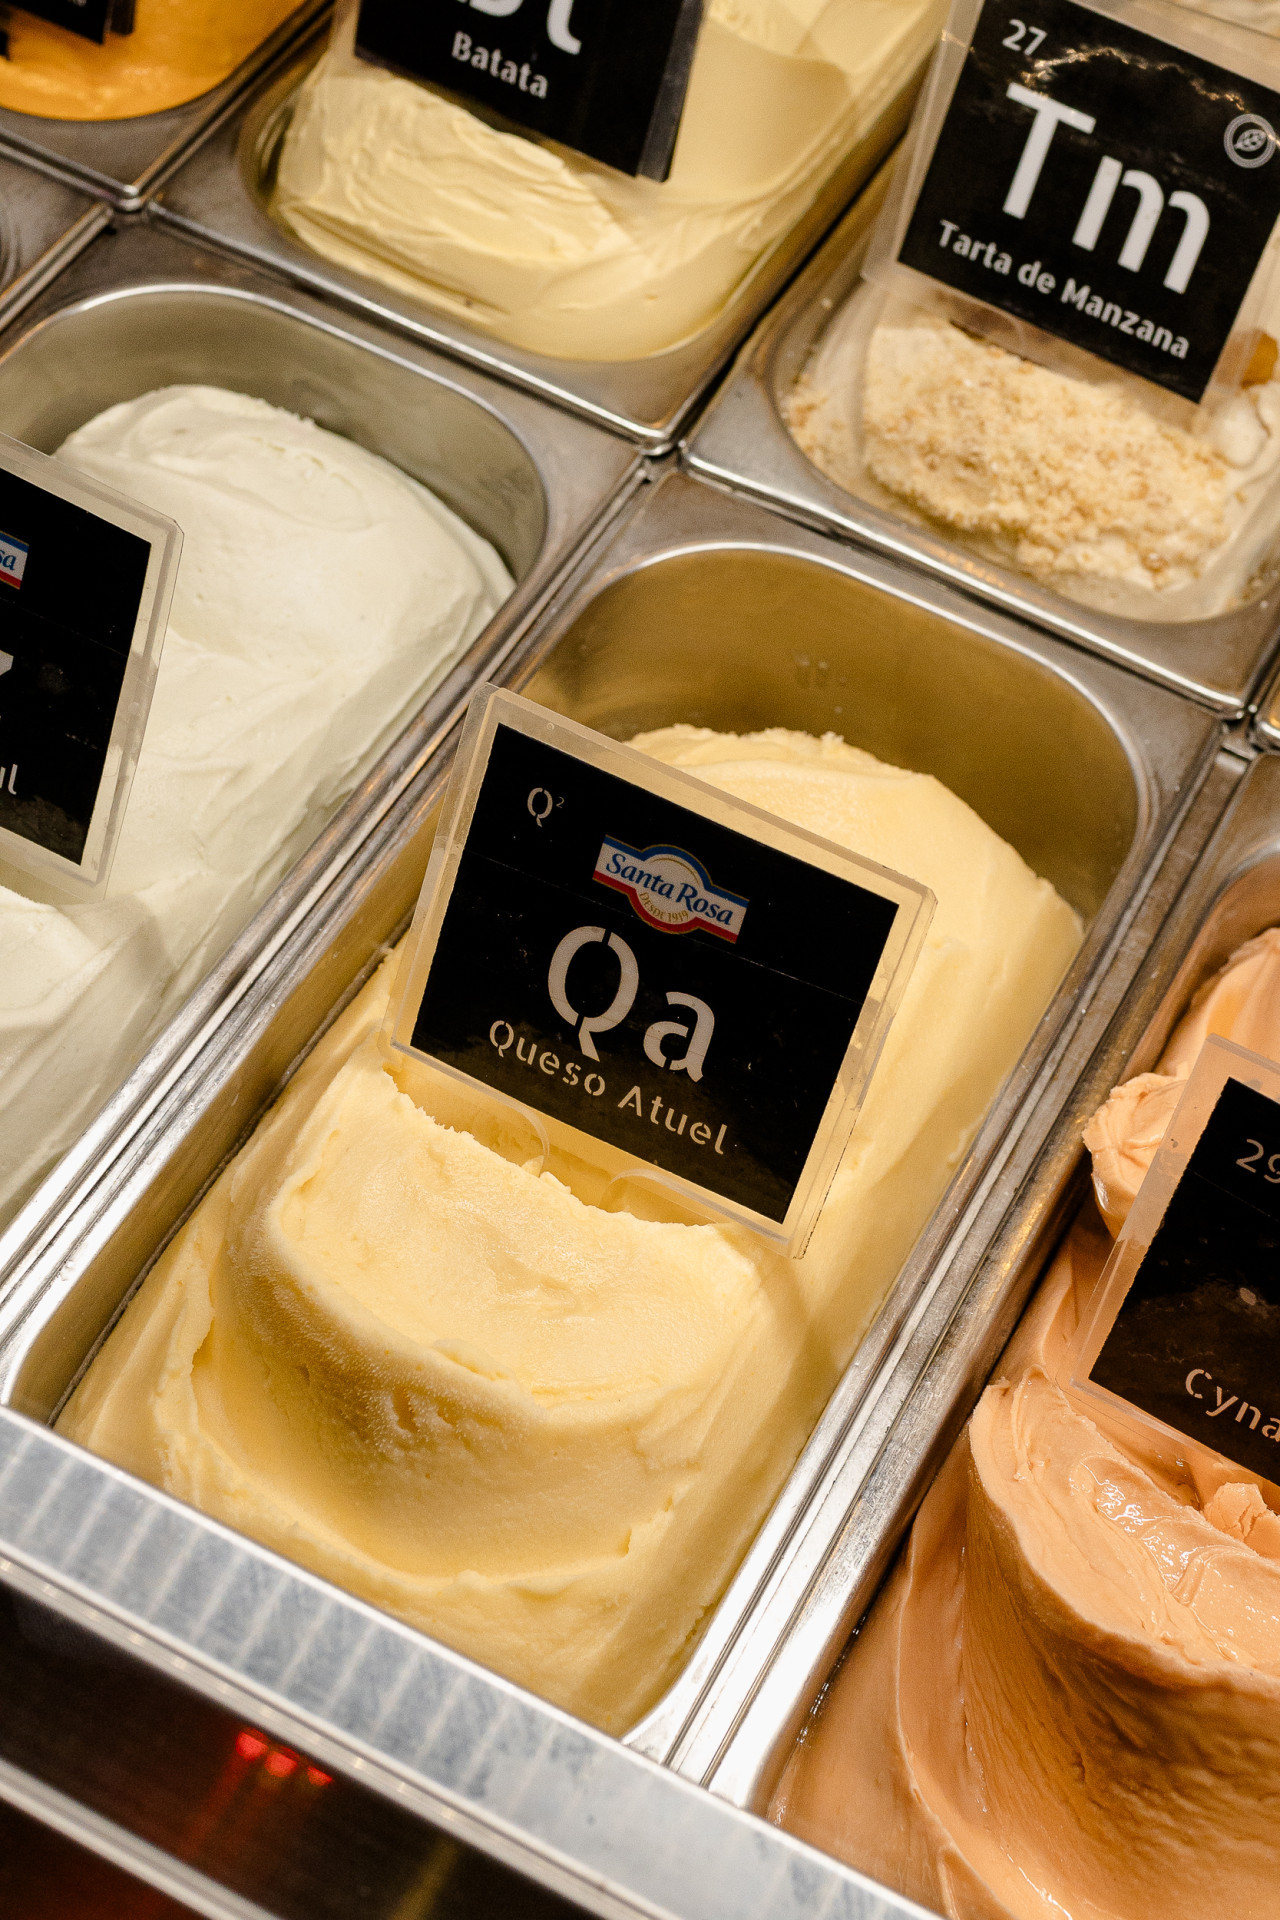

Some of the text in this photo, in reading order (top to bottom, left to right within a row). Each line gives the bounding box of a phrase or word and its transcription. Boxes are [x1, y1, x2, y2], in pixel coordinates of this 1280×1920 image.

[451, 31, 549, 99] Batata
[1001, 18, 1048, 56] 27
[1002, 82, 1211, 294] Tm
[939, 219, 1190, 360] Tarta de Manzana
[605, 853, 734, 926] Santa Rosa
[546, 924, 717, 1084] Qa
[488, 1019, 729, 1156] Queso Atuel
